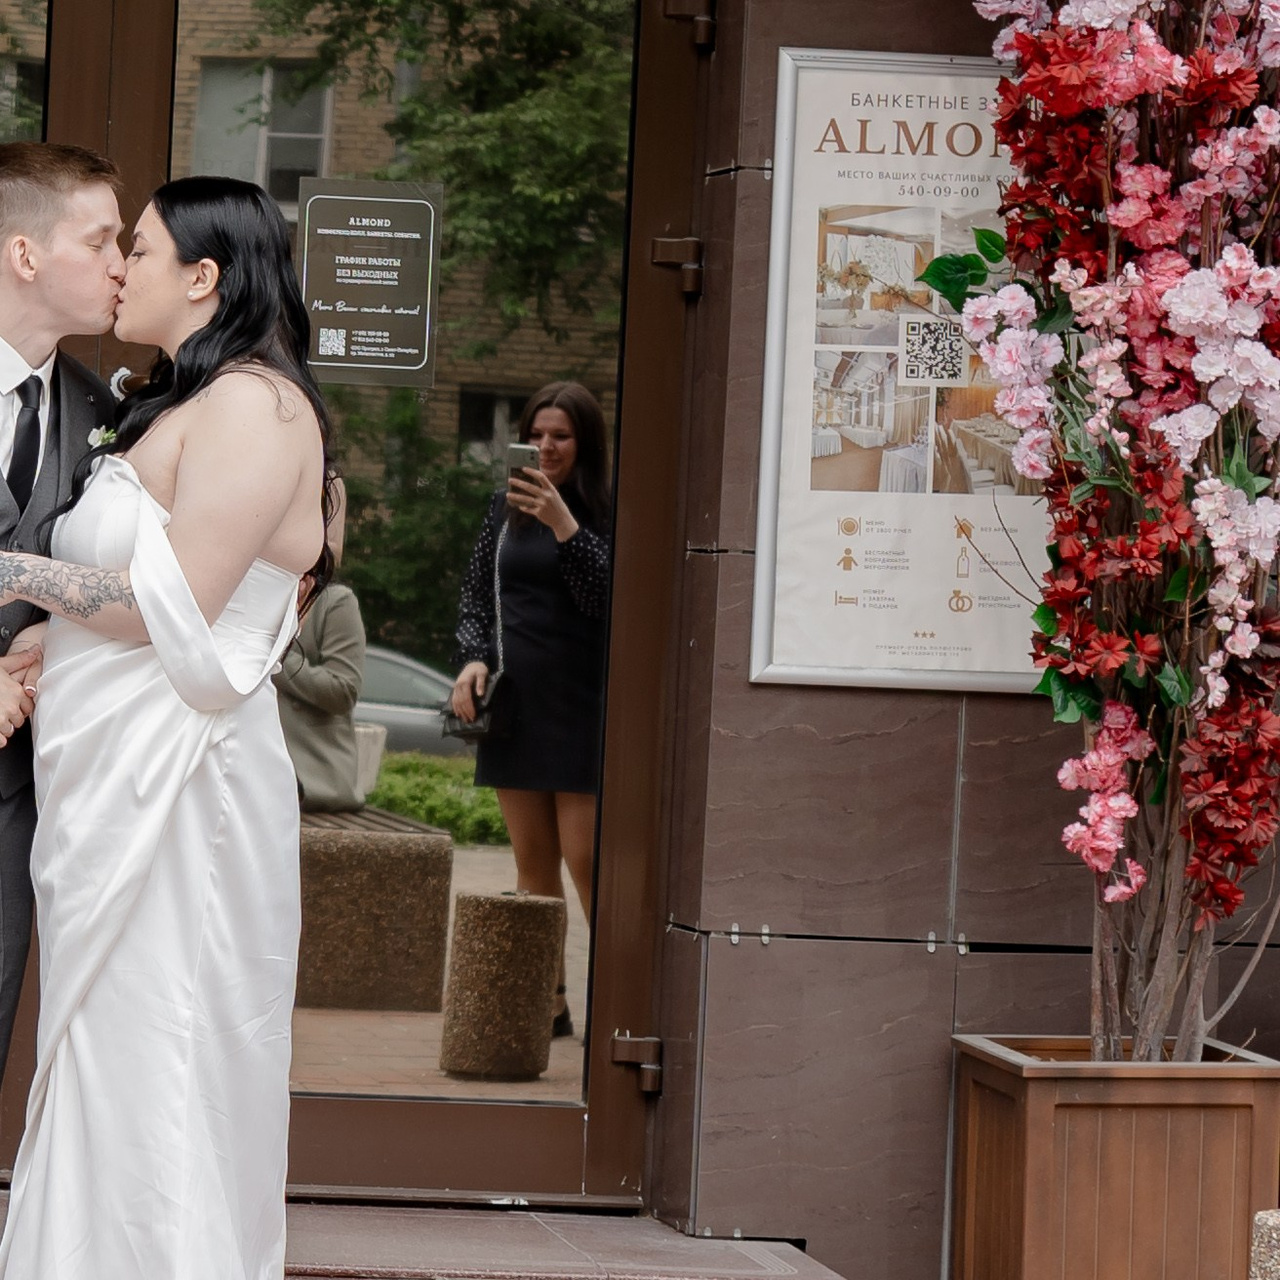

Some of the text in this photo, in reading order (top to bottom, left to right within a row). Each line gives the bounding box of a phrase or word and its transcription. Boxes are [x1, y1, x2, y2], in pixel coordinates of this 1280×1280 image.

[851, 92, 969, 110] БАНКЕТНЫЕ
[814, 117, 1005, 158] ALMO
[837, 170, 874, 180] МЕСТО
[878, 171, 917, 181] ВАШИХ
[920, 172, 991, 183] СЧАСТЛИВЫХ
[898, 185, 980, 198] 540-09-00
[348, 216, 391, 227] ALMOND
[368, 257, 402, 267] РАБОТЫ
